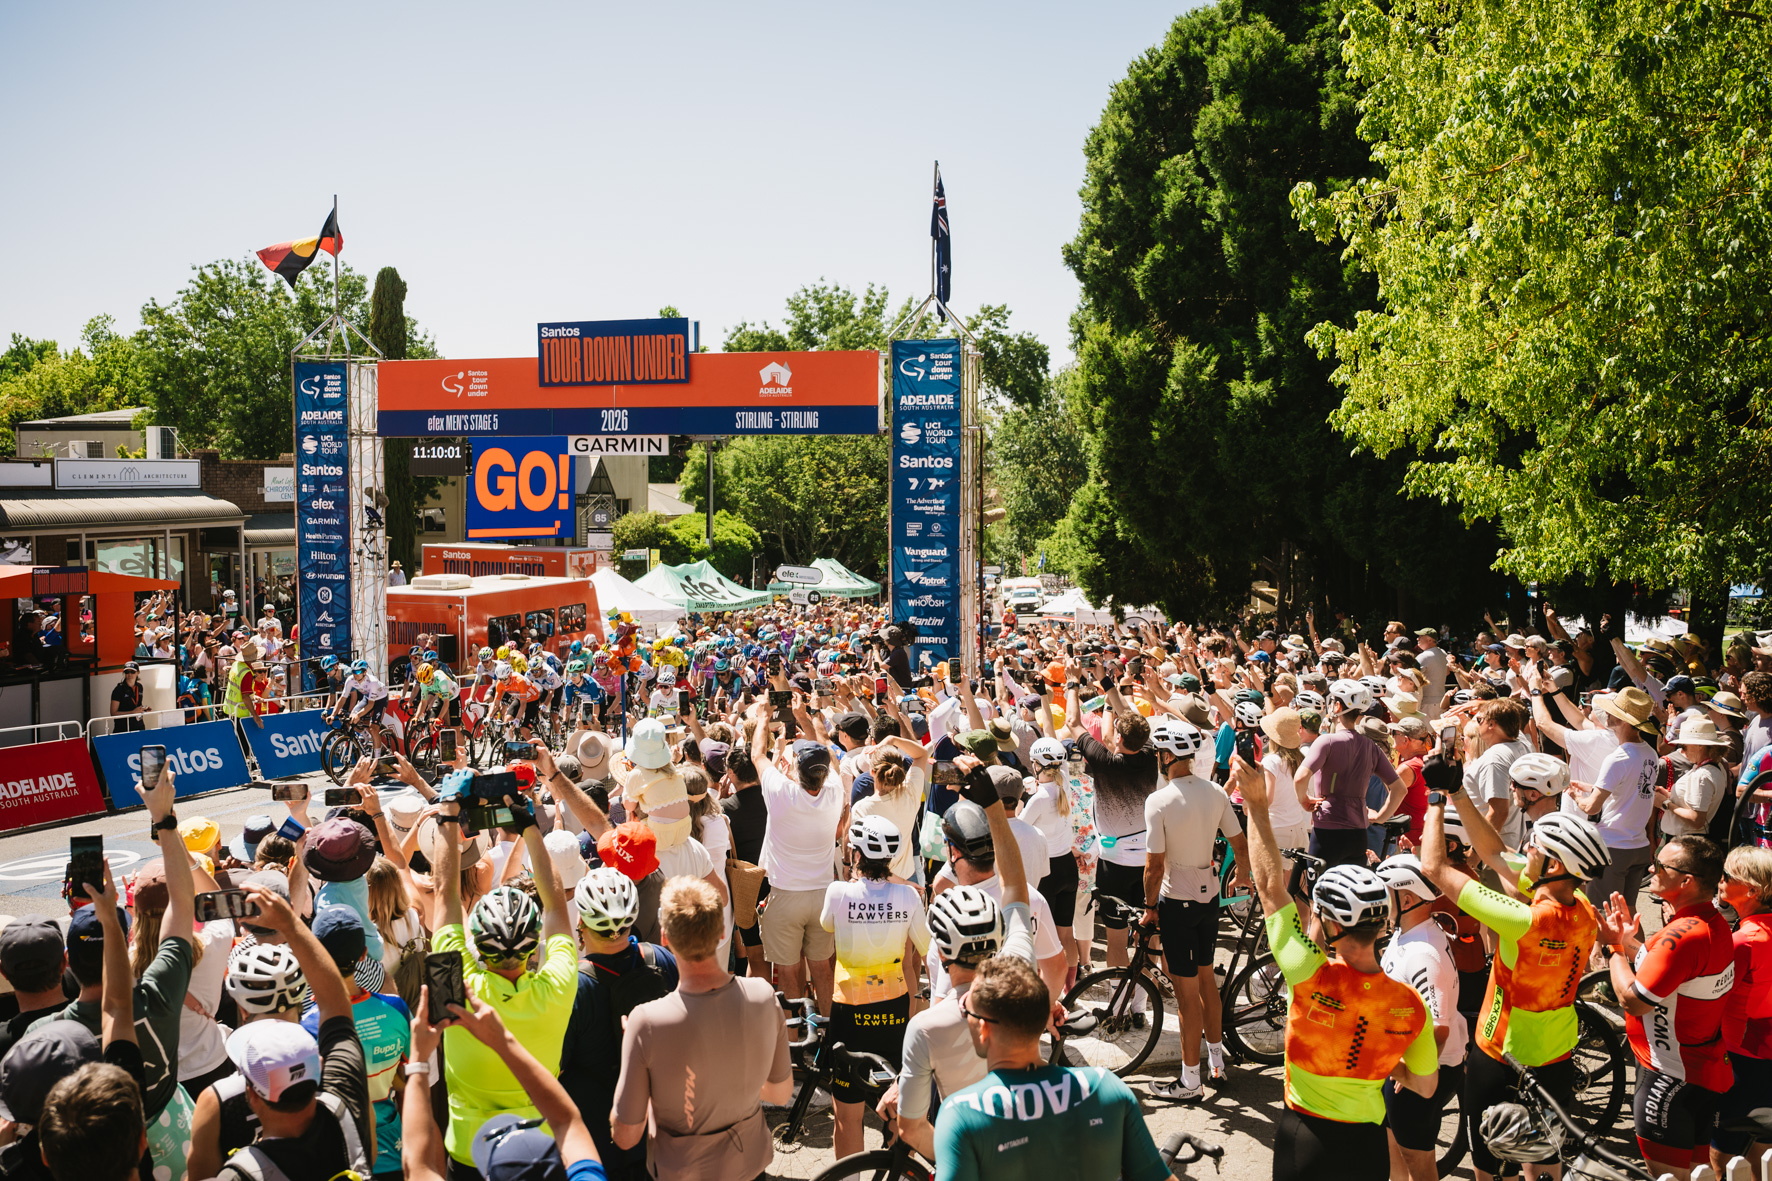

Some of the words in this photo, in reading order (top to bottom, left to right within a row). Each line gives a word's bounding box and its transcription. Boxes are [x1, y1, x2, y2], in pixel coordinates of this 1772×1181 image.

[541, 326, 580, 338] Santos
[541, 338, 581, 383] TOUR
[583, 336, 632, 382] DOWN
[633, 334, 686, 381] UNDER
[467, 370, 488, 379] Santos
[469, 383, 488, 391] down
[900, 395, 954, 406] ADELAIDE
[301, 411, 343, 420] ADELAIDE
[601, 409, 628, 431] 2026
[735, 411, 773, 429] STIRLING
[781, 411, 819, 429] STIRLING
[427, 416, 445, 431] efex
[445, 415, 469, 431] MEN'S
[469, 414, 492, 430] STAGE
[492, 413, 499, 430] 5
[925, 421, 941, 430] UCI
[925, 430, 954, 438] WORLD
[574, 437, 663, 453] GARMIN
[413, 446, 462, 458] 11:10:01
[900, 455, 953, 468] Santos
[302, 464, 343, 476] Santos
[474, 447, 571, 512] GO!
[312, 498, 335, 510] efex
[307, 517, 340, 525] GARMIN
[594, 514, 607, 523] 85
[311, 551, 337, 561] Hilton
[443, 550, 472, 563] Santos
[904, 547, 947, 558] Vanguard
[810, 594, 819, 602] 25
[270, 728, 340, 758] Santo
[1033, 747, 1052, 755] KASK
[127, 747, 224, 783] Sntos
[0, 772, 77, 800] ADELAIDE
[0, 796, 31, 810] SOUTH
[33, 788, 80, 803] AUSTRALIA
[848, 902, 893, 911] HONES
[848, 911, 908, 920] LAWYERS
[1661, 918, 1699, 951] RCMC
[1714, 968, 1734, 988] REDLA
[855, 1017, 906, 1026] LAWYERS
[1485, 1014, 1497, 1038] SHEEP
[1653, 1003, 1671, 1052] RCMC
[373, 1043, 395, 1055] Bupa
[684, 1064, 696, 1128] MAAP
[1645, 1075, 1674, 1125] REDLAND
